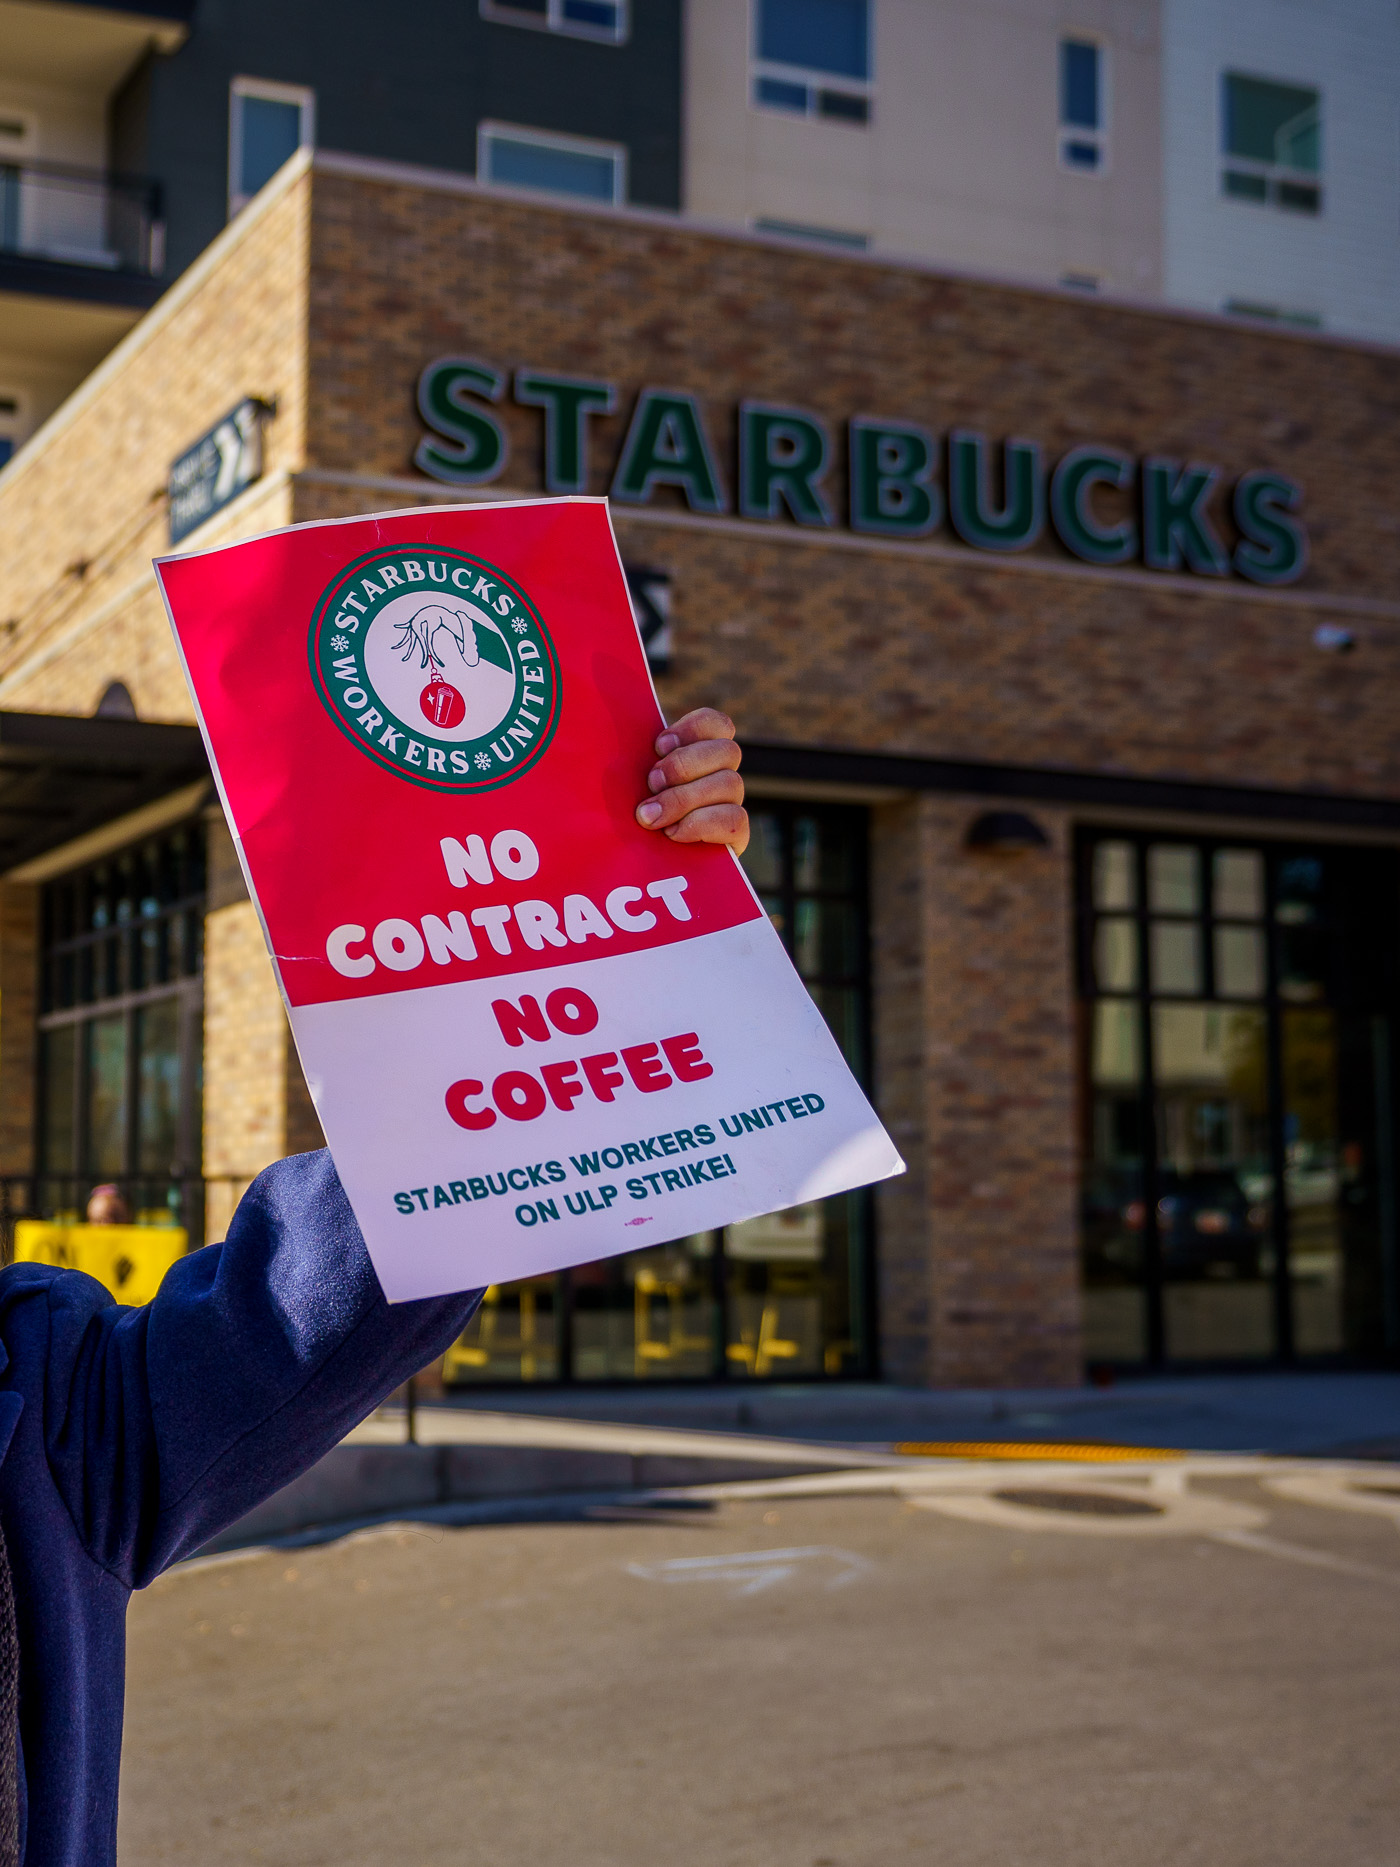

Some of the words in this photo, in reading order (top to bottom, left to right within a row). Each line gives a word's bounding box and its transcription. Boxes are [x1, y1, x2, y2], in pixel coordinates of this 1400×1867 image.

[413, 354, 1309, 586] STARBUCKS
[334, 560, 516, 633] STARBUCKS
[332, 654, 470, 775] WORKERS
[490, 639, 545, 763] UNITED
[439, 829, 539, 888] NO
[326, 875, 691, 978] CONTRACT
[491, 987, 599, 1047] NO
[445, 1032, 713, 1131] COFFEE
[393, 1160, 567, 1215] STARBUCKS
[569, 1123, 716, 1177] WORKERS
[719, 1092, 825, 1138] UNITED
[514, 1199, 561, 1227] ON
[563, 1185, 619, 1216] ULP
[626, 1153, 737, 1199] STRIKE!
